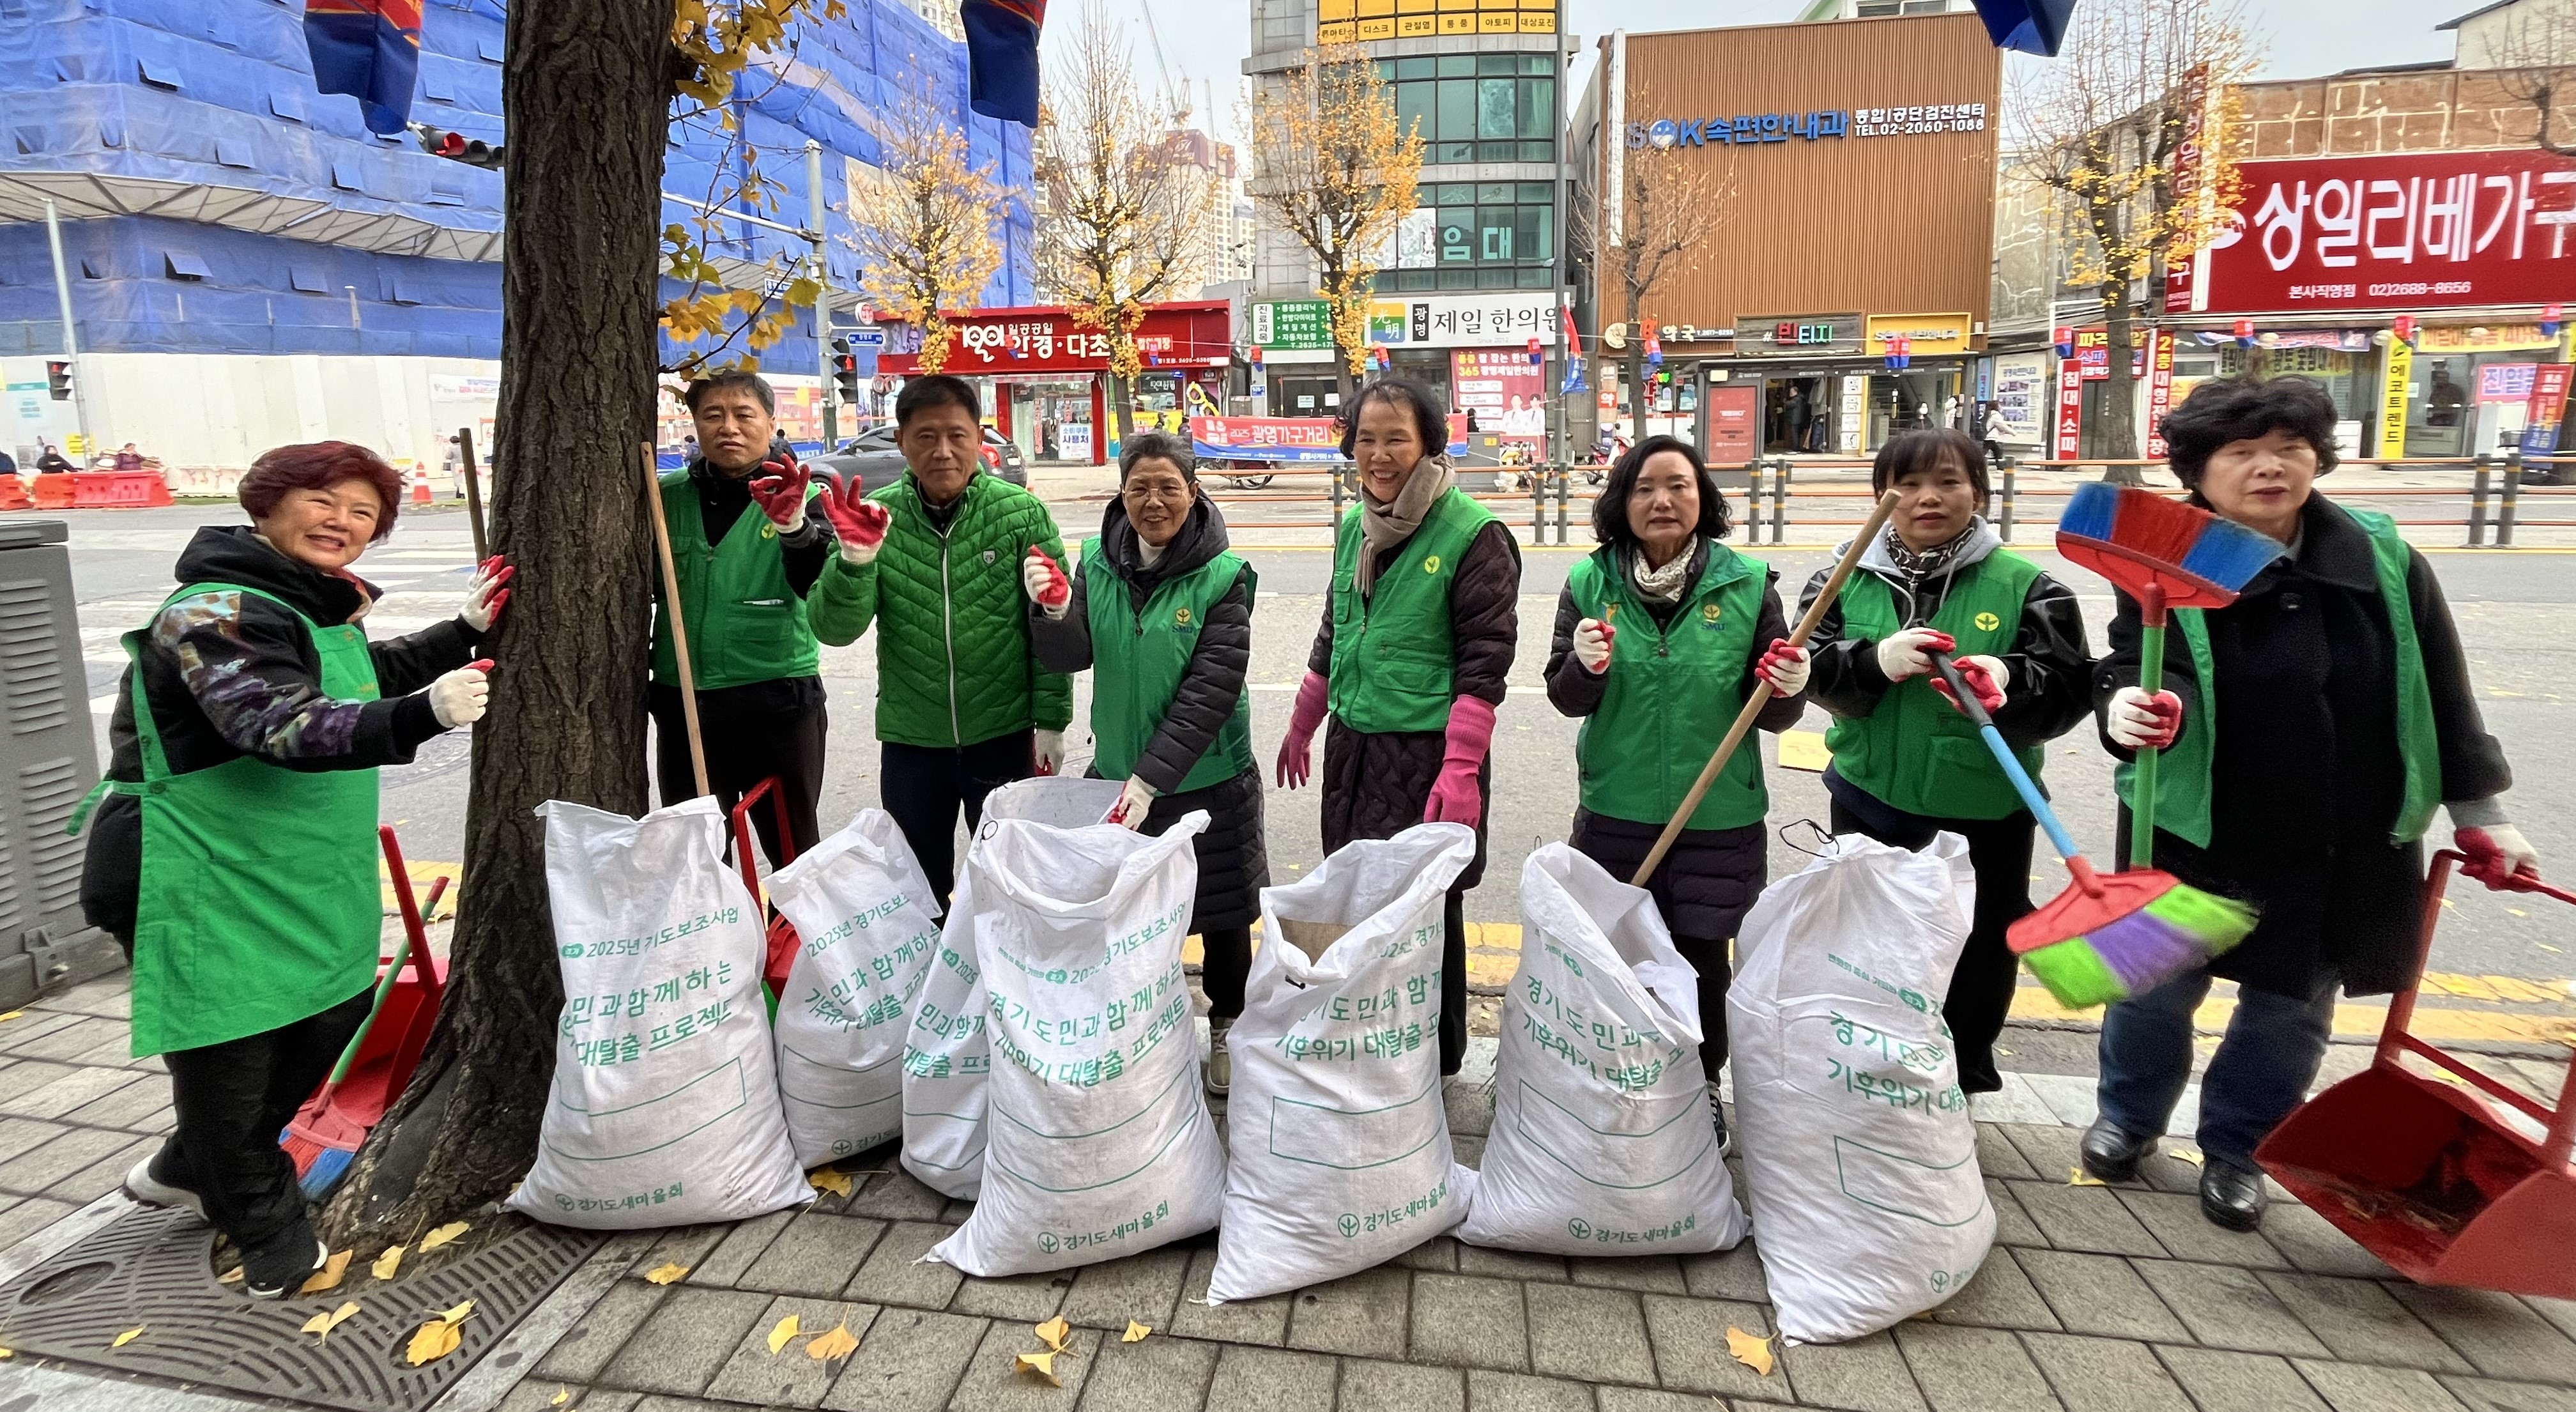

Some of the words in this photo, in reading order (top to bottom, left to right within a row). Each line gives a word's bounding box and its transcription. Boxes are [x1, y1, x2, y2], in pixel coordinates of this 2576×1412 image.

[1363, 24, 1389, 33] 디스크
[1485, 18, 1510, 27] 아토피
[1521, 18, 1554, 27] 대상포진
[1855, 118, 1984, 137] TEL.02-2060-1088
[2288, 283, 2357, 299] 본사직영점
[2368, 281, 2471, 297] 02)2688-8656
[1008, 322, 1054, 335] 일공공일
[1257, 305, 1269, 342] 진료과목
[1414, 306, 1428, 337] 광명
[1662, 324, 1696, 342] 약국
[2156, 335, 2172, 369] 2층
[1458, 366, 1480, 376] 365
[1600, 393, 1616, 407] 약
[2386, 364, 2406, 443] 에코트렌드
[1062, 434, 1089, 443] 사용처
[1230, 428, 1250, 438] 2025
[1252, 425, 1329, 444] 광명가구거리
[586, 937, 640, 958] 2025년
[807, 919, 854, 958] 2025년
[954, 960, 979, 986] 2025
[1058, 1048, 1124, 1088] 대탈출
[1132, 993, 1186, 1065] 프로젝트
[1363, 1022, 1423, 1059] 대탈출
[1827, 1057, 1931, 1116] 기후위기
[578, 1181, 684, 1212] 경기도새마을회
[1363, 1176, 1447, 1232] 경기도새마을회
[1063, 1199, 1169, 1250] 경기도새마을회
[1595, 1211, 1696, 1244] 경기도새마을회
